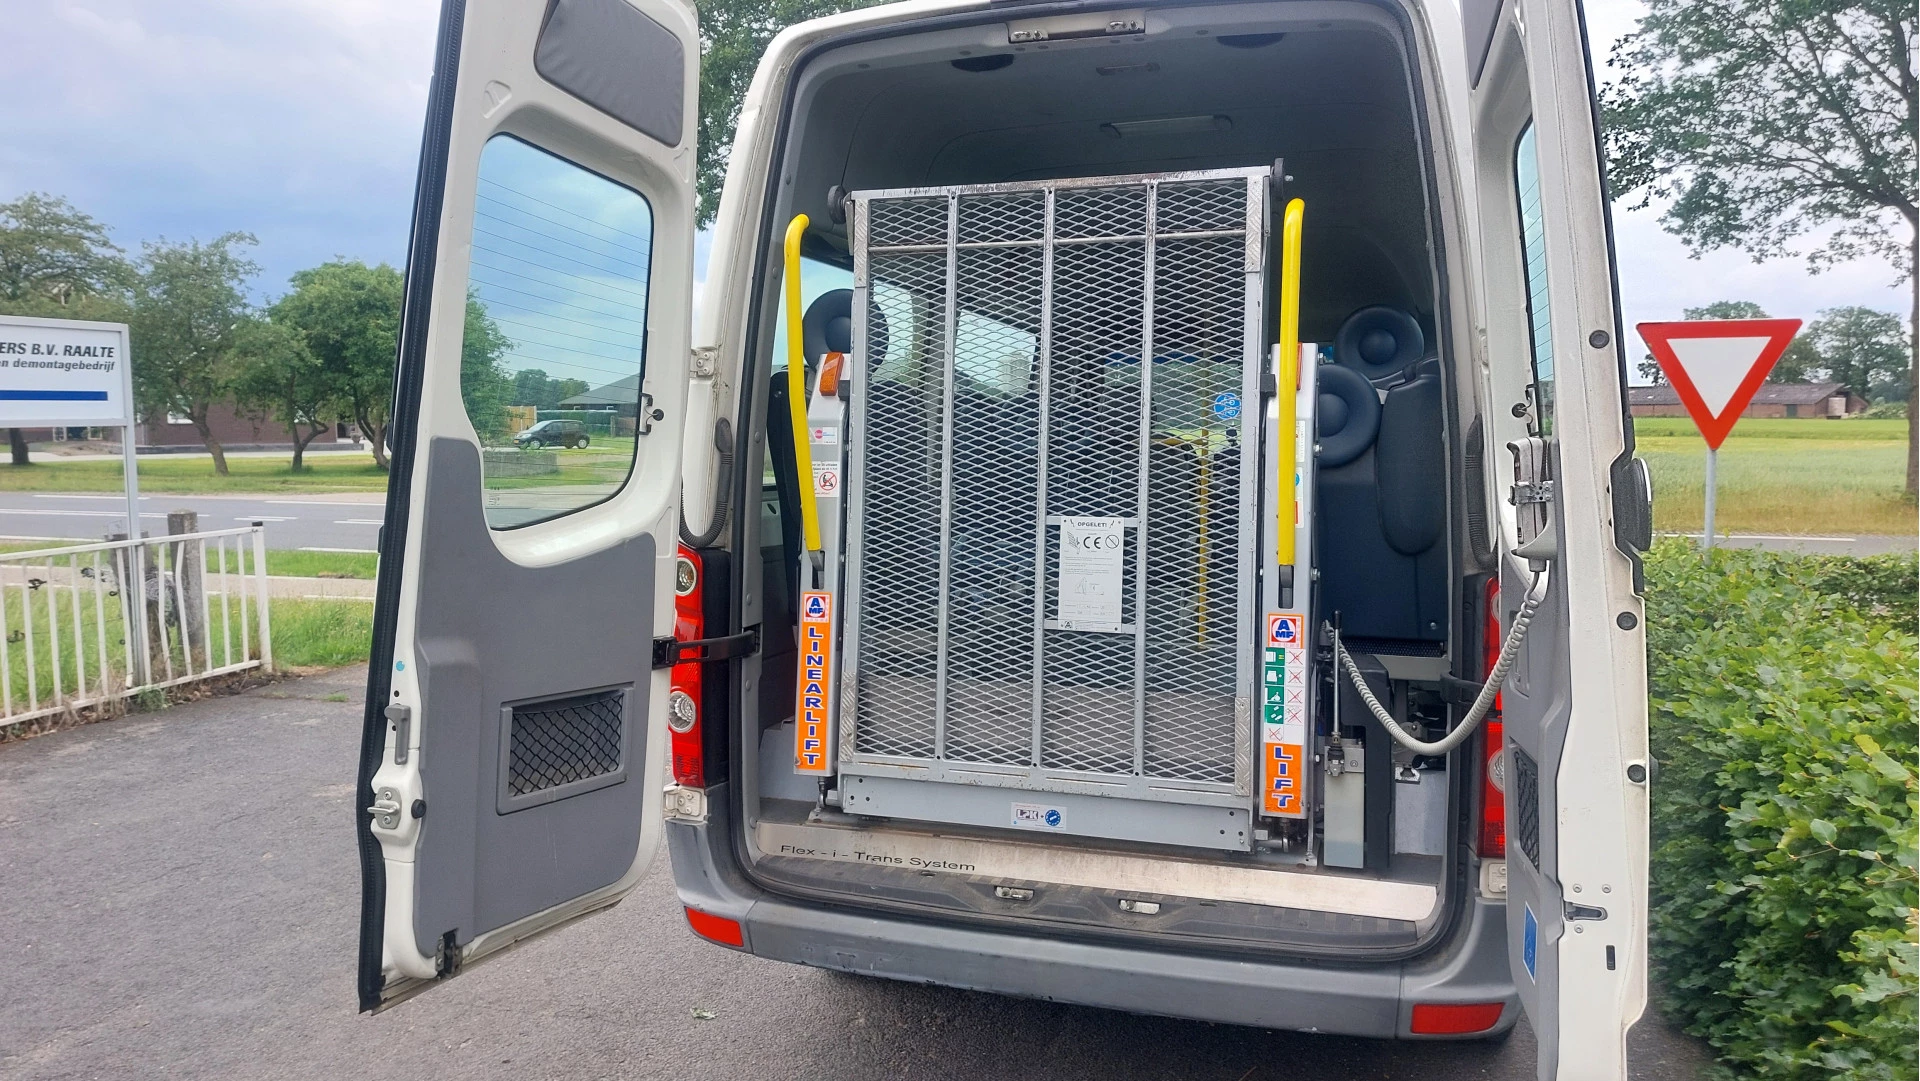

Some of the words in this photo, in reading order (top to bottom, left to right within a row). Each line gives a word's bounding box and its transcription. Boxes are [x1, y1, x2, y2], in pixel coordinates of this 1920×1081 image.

[0, 342, 27, 355] ERS
[31, 343, 58, 356] B.V.
[63, 345, 115, 358] RAALTE
[0, 360, 9, 368] n
[13, 358, 115, 373] demontagebedrijf
[1083, 536, 1102, 549] CE
[803, 626, 824, 766] LINEARLIFT
[1272, 745, 1294, 809] LIFT
[780, 844, 816, 856] Flex
[854, 851, 903, 864] Trans
[909, 857, 976, 871] System
